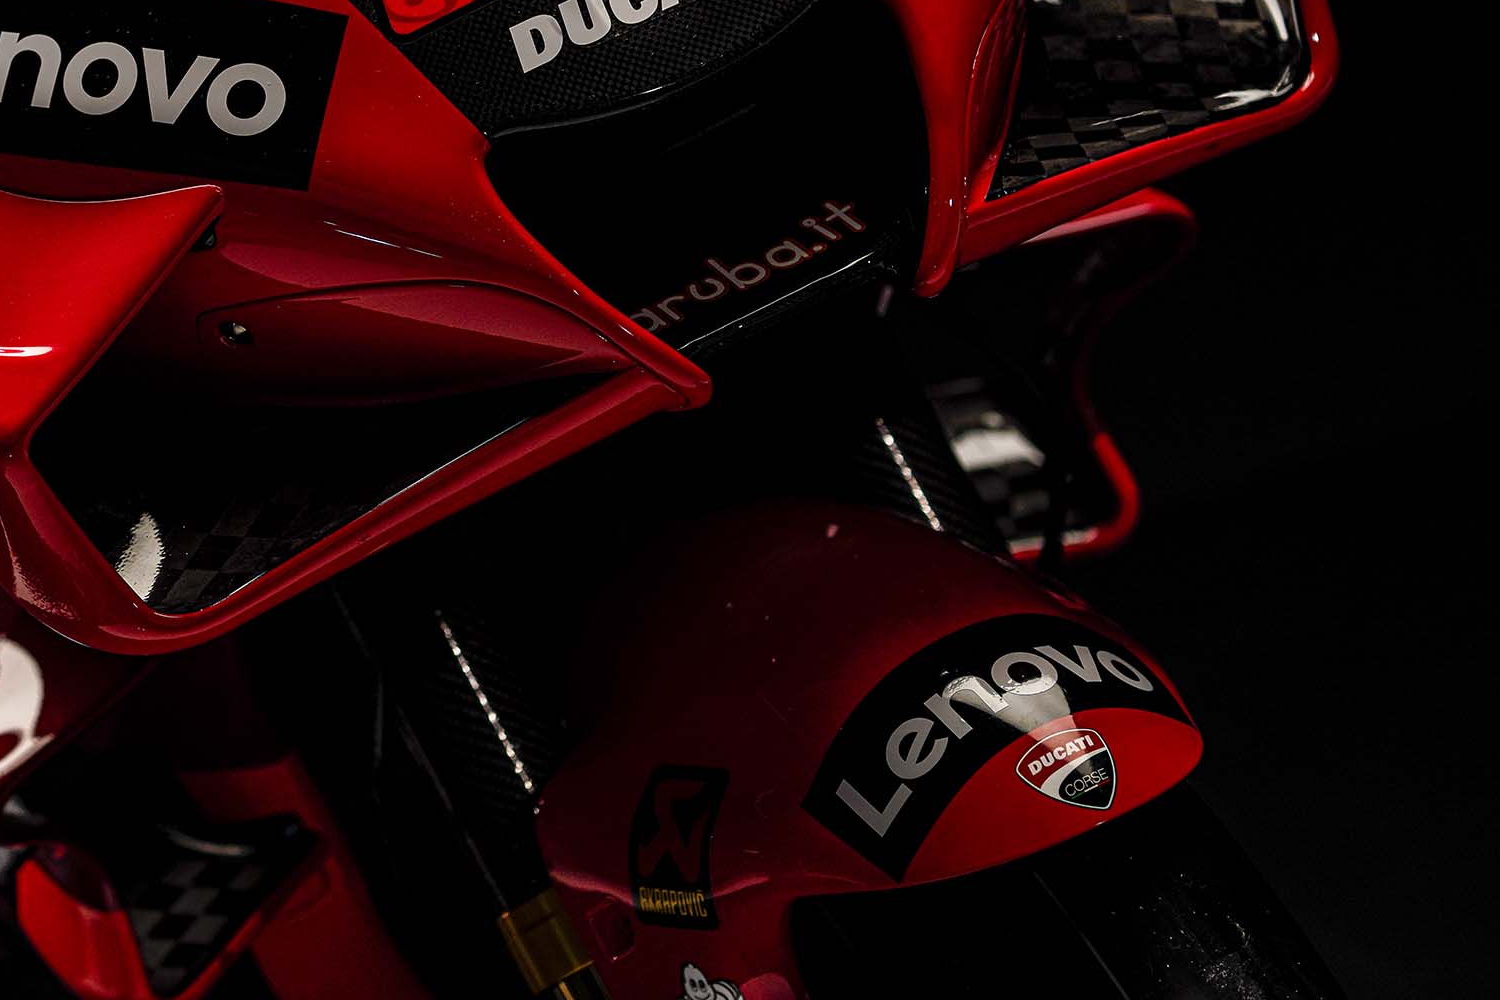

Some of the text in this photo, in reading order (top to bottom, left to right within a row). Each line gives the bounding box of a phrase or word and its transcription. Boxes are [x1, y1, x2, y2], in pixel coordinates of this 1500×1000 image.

[835, 643, 1154, 838] Lenovo
[1027, 734, 1094, 776] DUCATI
[1064, 767, 1109, 797] CORSE
